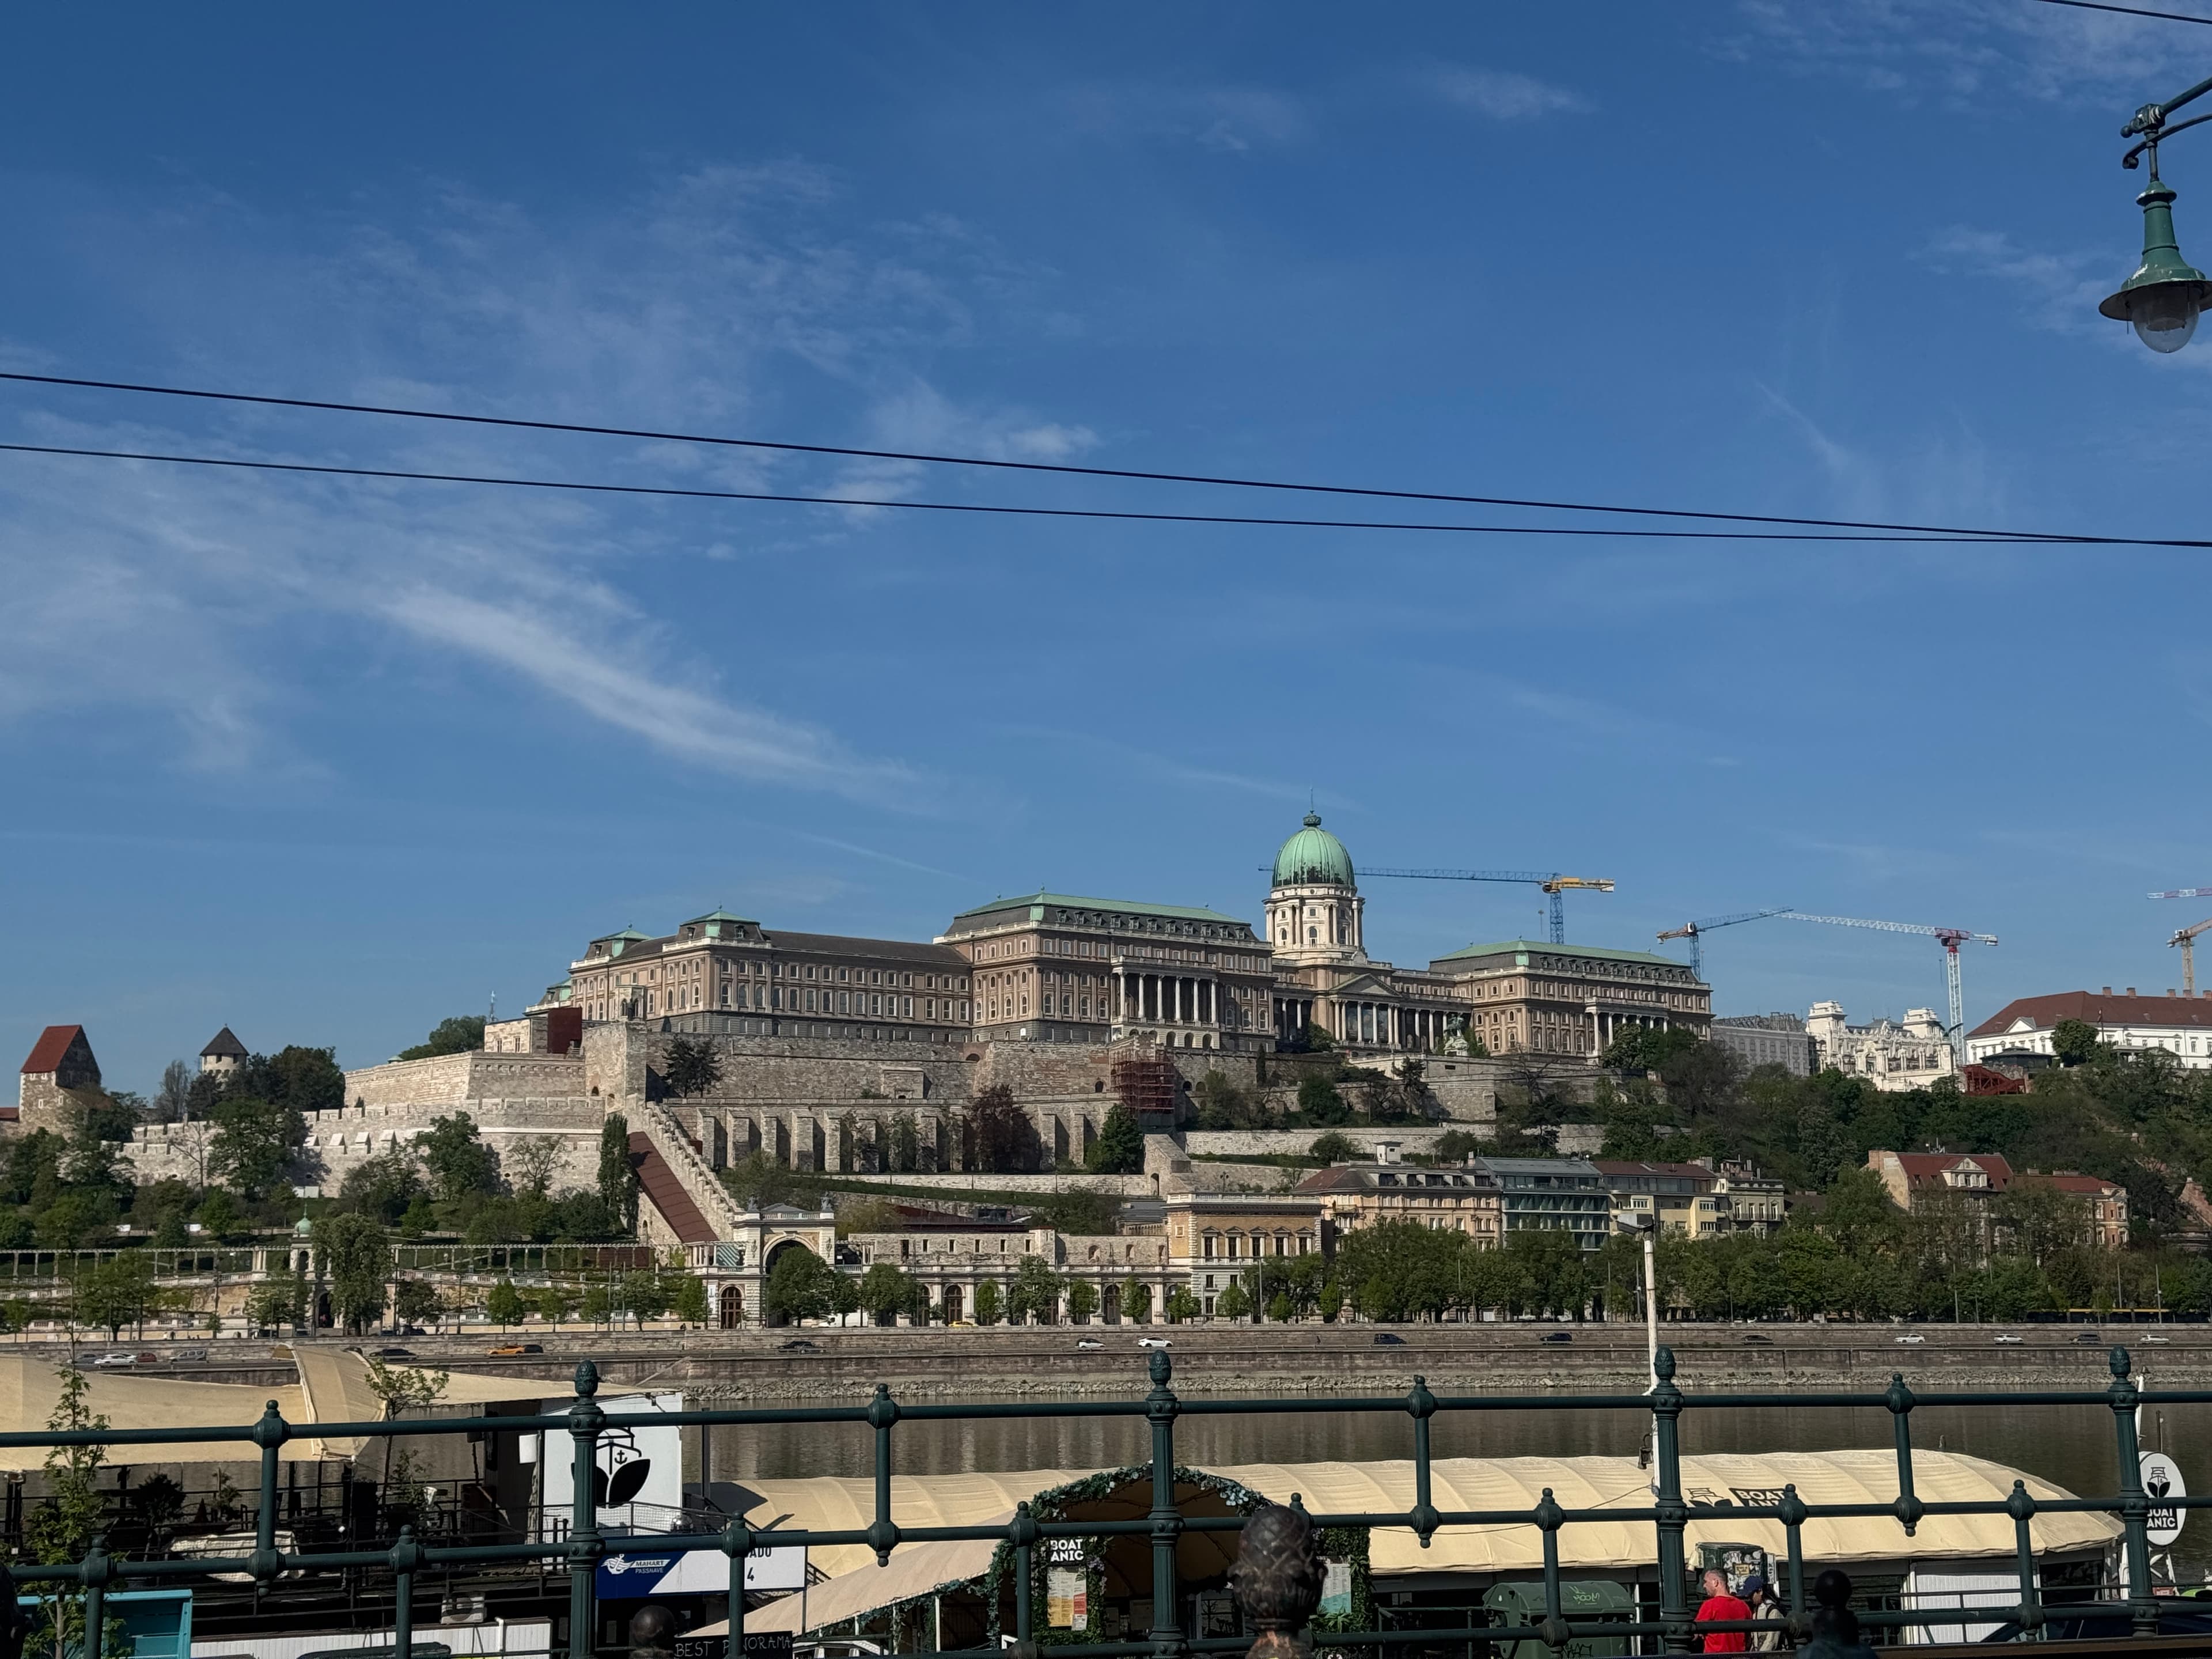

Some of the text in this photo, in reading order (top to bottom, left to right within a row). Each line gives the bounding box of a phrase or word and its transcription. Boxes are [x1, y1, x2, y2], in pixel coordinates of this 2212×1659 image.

[1735, 1490, 1785, 1500] BOAT
[2146, 1517, 2176, 1528] ANIC
[1050, 1539, 1084, 1551] BOAT
[1050, 1550, 1084, 1562] ANIC
[674, 1641, 714, 1657] BEST
